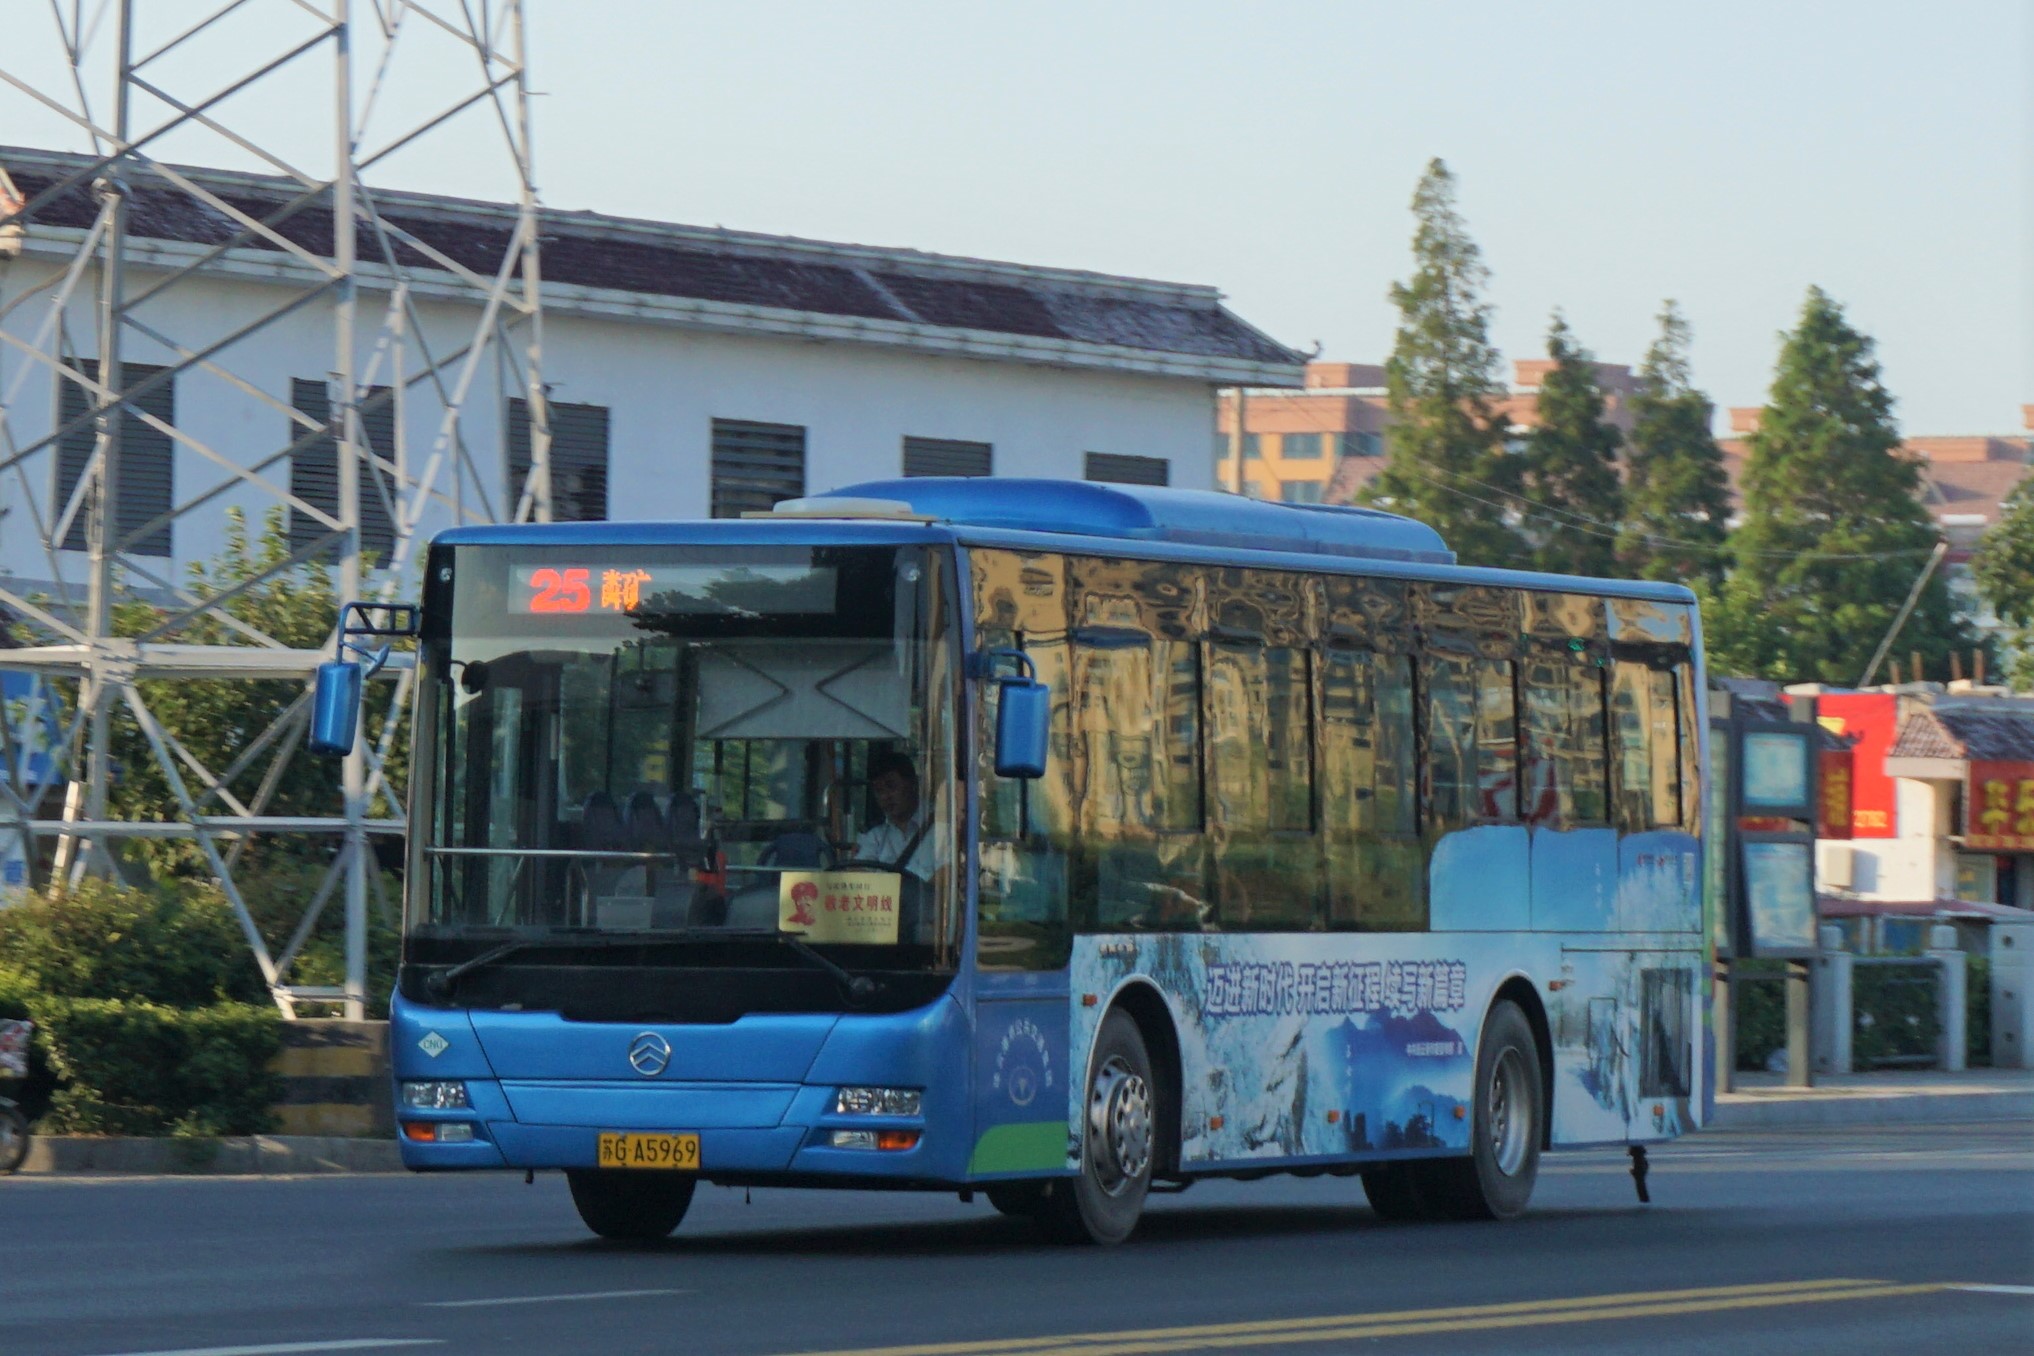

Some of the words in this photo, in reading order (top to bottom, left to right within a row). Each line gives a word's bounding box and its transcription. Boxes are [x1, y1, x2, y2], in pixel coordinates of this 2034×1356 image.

[530, 568, 591, 613] 25
[824, 894, 893, 912] 敬老文明线
[1204, 961, 1294, 1016] 迈进新时代
[1296, 960, 1383, 1014] 开启新征程
[1384, 958, 1467, 1013] 续写新篇章
[423, 1039, 443, 1050] CNG
